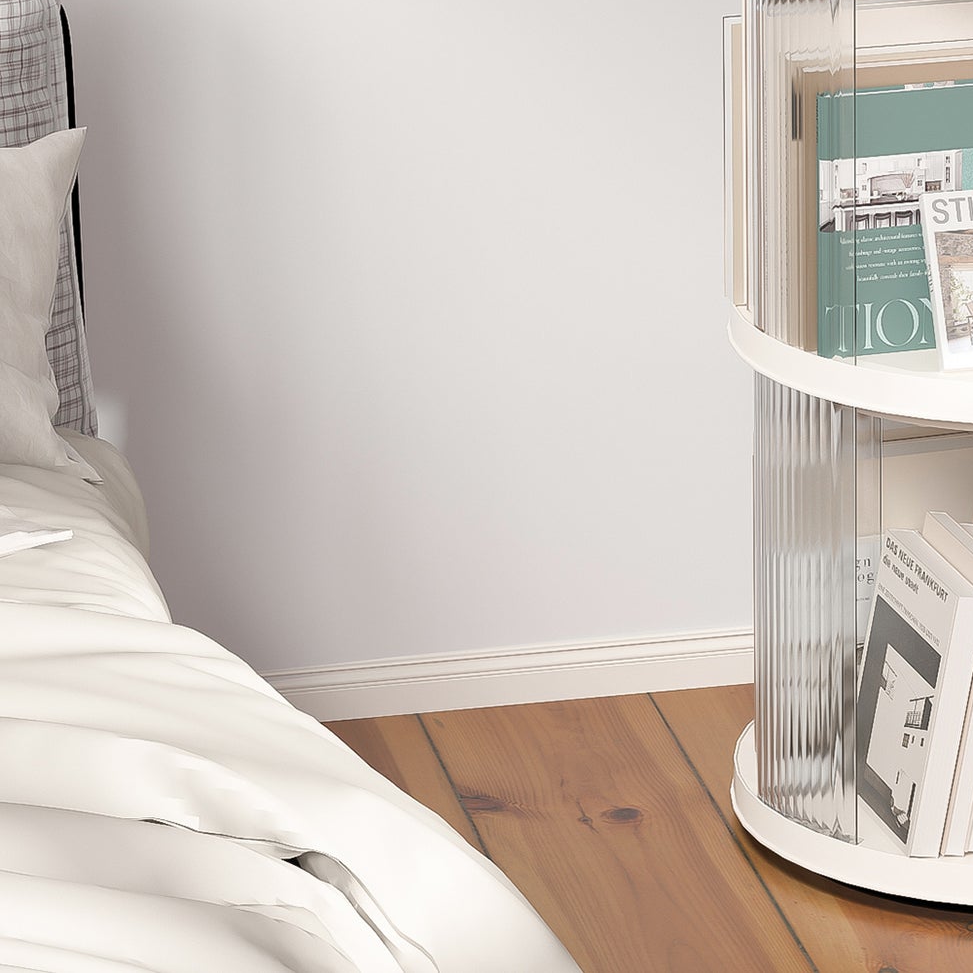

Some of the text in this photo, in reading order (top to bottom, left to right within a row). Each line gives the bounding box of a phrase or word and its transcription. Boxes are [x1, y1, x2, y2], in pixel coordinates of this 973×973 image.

[885, 537, 948, 603] DAS NEUE FRANKFURT
